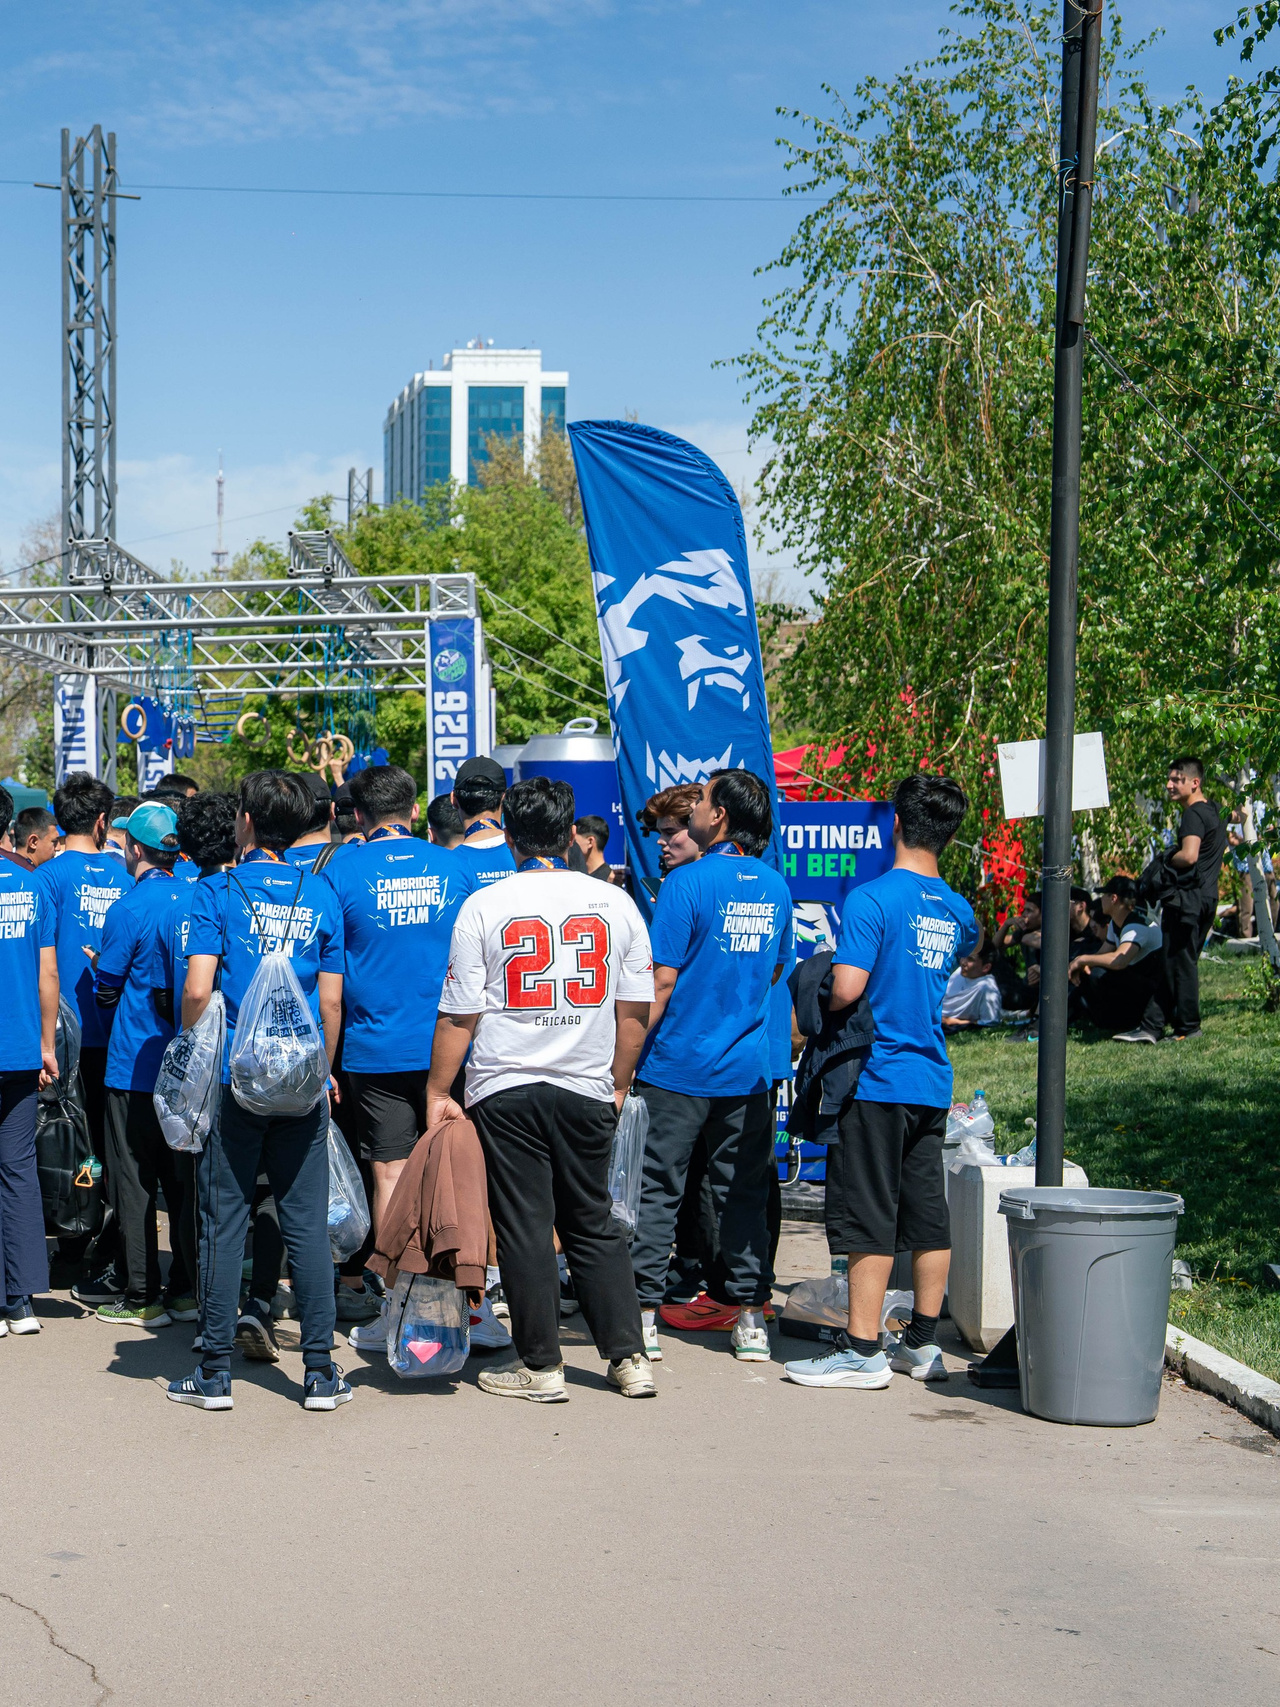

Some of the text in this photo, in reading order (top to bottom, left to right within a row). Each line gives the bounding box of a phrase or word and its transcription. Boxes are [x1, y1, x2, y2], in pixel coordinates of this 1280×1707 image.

[434, 691, 468, 780] 2026
[477, 870, 516, 879] CAMBRID
[807, 854, 856, 877] BER
[377, 876, 440, 892] CAMBRIDGE
[377, 889, 440, 910] RUNNING
[726, 902, 775, 916] CAMBRIDGE
[252, 901, 313, 922] CAMBRIDGE
[388, 906, 429, 926] TEAM
[0, 922, 25, 939] TEAM
[250, 916, 312, 940] RUNNING
[723, 915, 773, 934] RUNNING
[501, 912, 611, 1011] 23
[534, 1015, 581, 1027] CHICAGO
